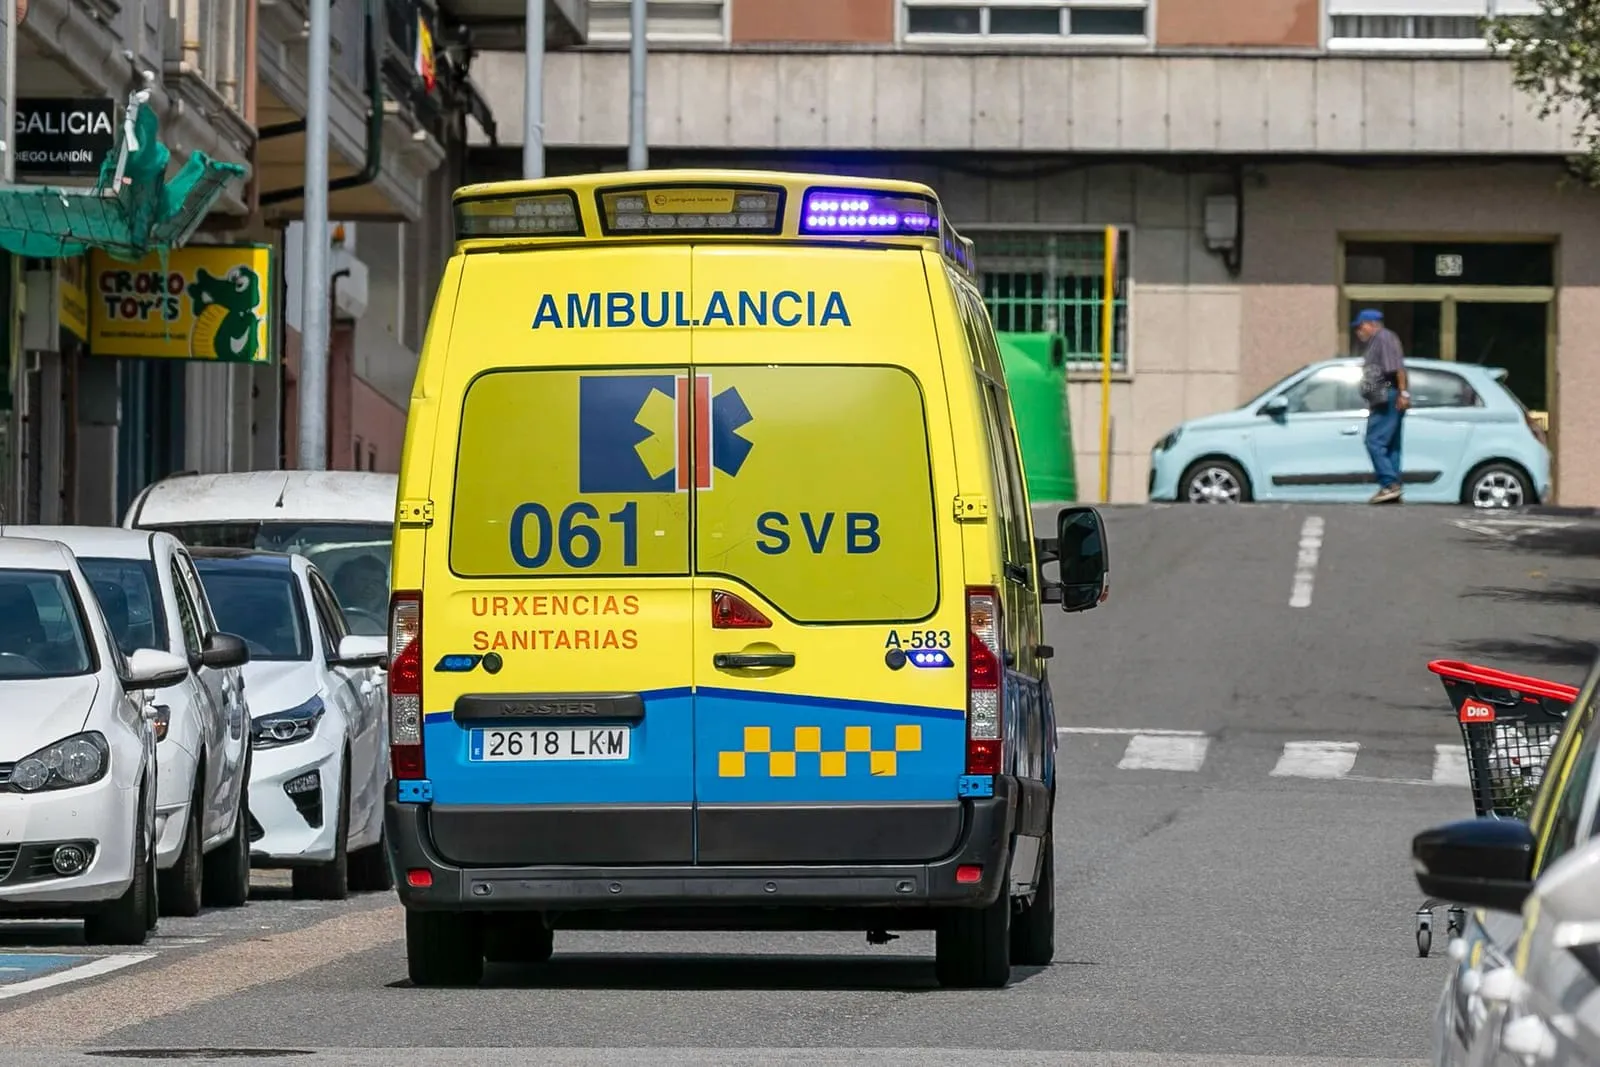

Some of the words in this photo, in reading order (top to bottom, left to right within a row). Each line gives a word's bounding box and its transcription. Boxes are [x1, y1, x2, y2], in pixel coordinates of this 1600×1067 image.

[14, 111, 112, 135] GALICIA
[49, 149, 93, 163] LANDÍN
[99, 269, 185, 296] CROKO
[105, 296, 180, 320] TOY'S
[532, 291, 852, 330] AMBULANCIA
[509, 501, 639, 569] 061
[756, 511, 882, 555] SVB
[472, 595, 639, 616] URXENCIAS
[472, 629, 639, 651] SANITARIAS
[885, 630, 951, 648] A-583
[502, 703, 597, 715] MASTER
[490, 731, 559, 756] 2618
[571, 730, 624, 755] LKM
